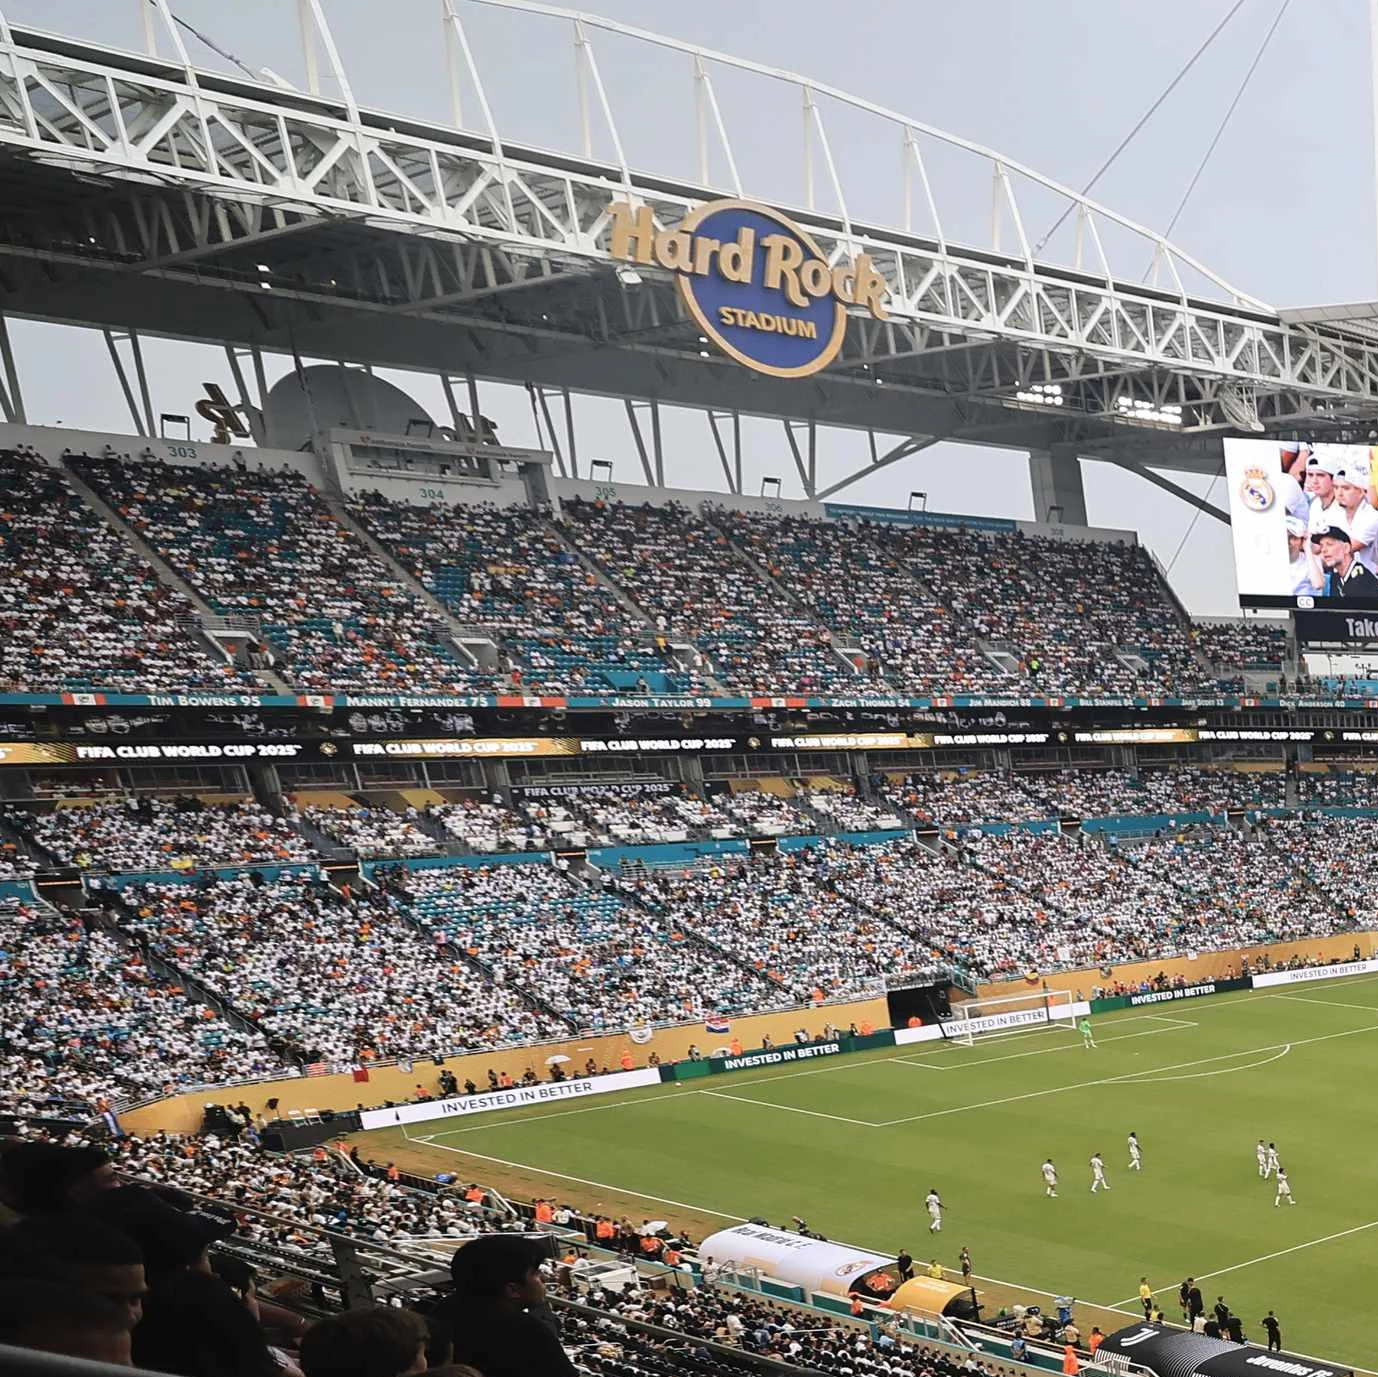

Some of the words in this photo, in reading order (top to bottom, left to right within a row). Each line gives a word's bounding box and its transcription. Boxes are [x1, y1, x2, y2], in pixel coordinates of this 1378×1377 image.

[609, 202, 755, 283] Hard
[761, 234, 889, 320] Rock
[718, 306, 817, 339] STADIUM
[167, 446, 198, 458] 303
[420, 488, 444, 500] 304
[148, 696, 176, 706] TIM
[178, 696, 237, 706] BOWENS
[240, 696, 261, 706] 95
[346, 696, 398, 707] MANNY
[399, 696, 468, 708] FERNANDEZ
[612, 698, 648, 708] JASON
[650, 698, 694, 708] TAYLOR
[832, 699, 857, 708] ZACH
[76, 747, 116, 758] FIFA
[116, 746, 161, 757] CLUB
[162, 746, 222, 757] WORLD
[223, 745, 256, 756] CUP
[581, 741, 608, 751] FIFA
[608, 741, 638, 750] CLUB
[639, 740, 680, 750] WORLD
[681, 739, 703, 749] CUP
[524, 788, 548, 797] FIFA
[1290, 969, 1328, 980] INVESTED
[1340, 964, 1366, 973] BETTER
[1132, 991, 1173, 1004] INVESTED
[1174, 990, 1184, 998] IN
[1185, 985, 1215, 997] BETTER
[947, 1017, 995, 1034] INVESTED
[997, 1015, 1007, 1024] IN
[1009, 1009, 1044, 1023] BETTER
[725, 1052, 781, 1069] INVESTED
[784, 1050, 796, 1059] IN
[798, 1044, 839, 1057] BETTER
[442, 1094, 516, 1113] INVESTED
[521, 1091, 535, 1101] IN
[540, 1083, 592, 1098] BETTER
[1246, 1356, 1314, 1376] Juventus
